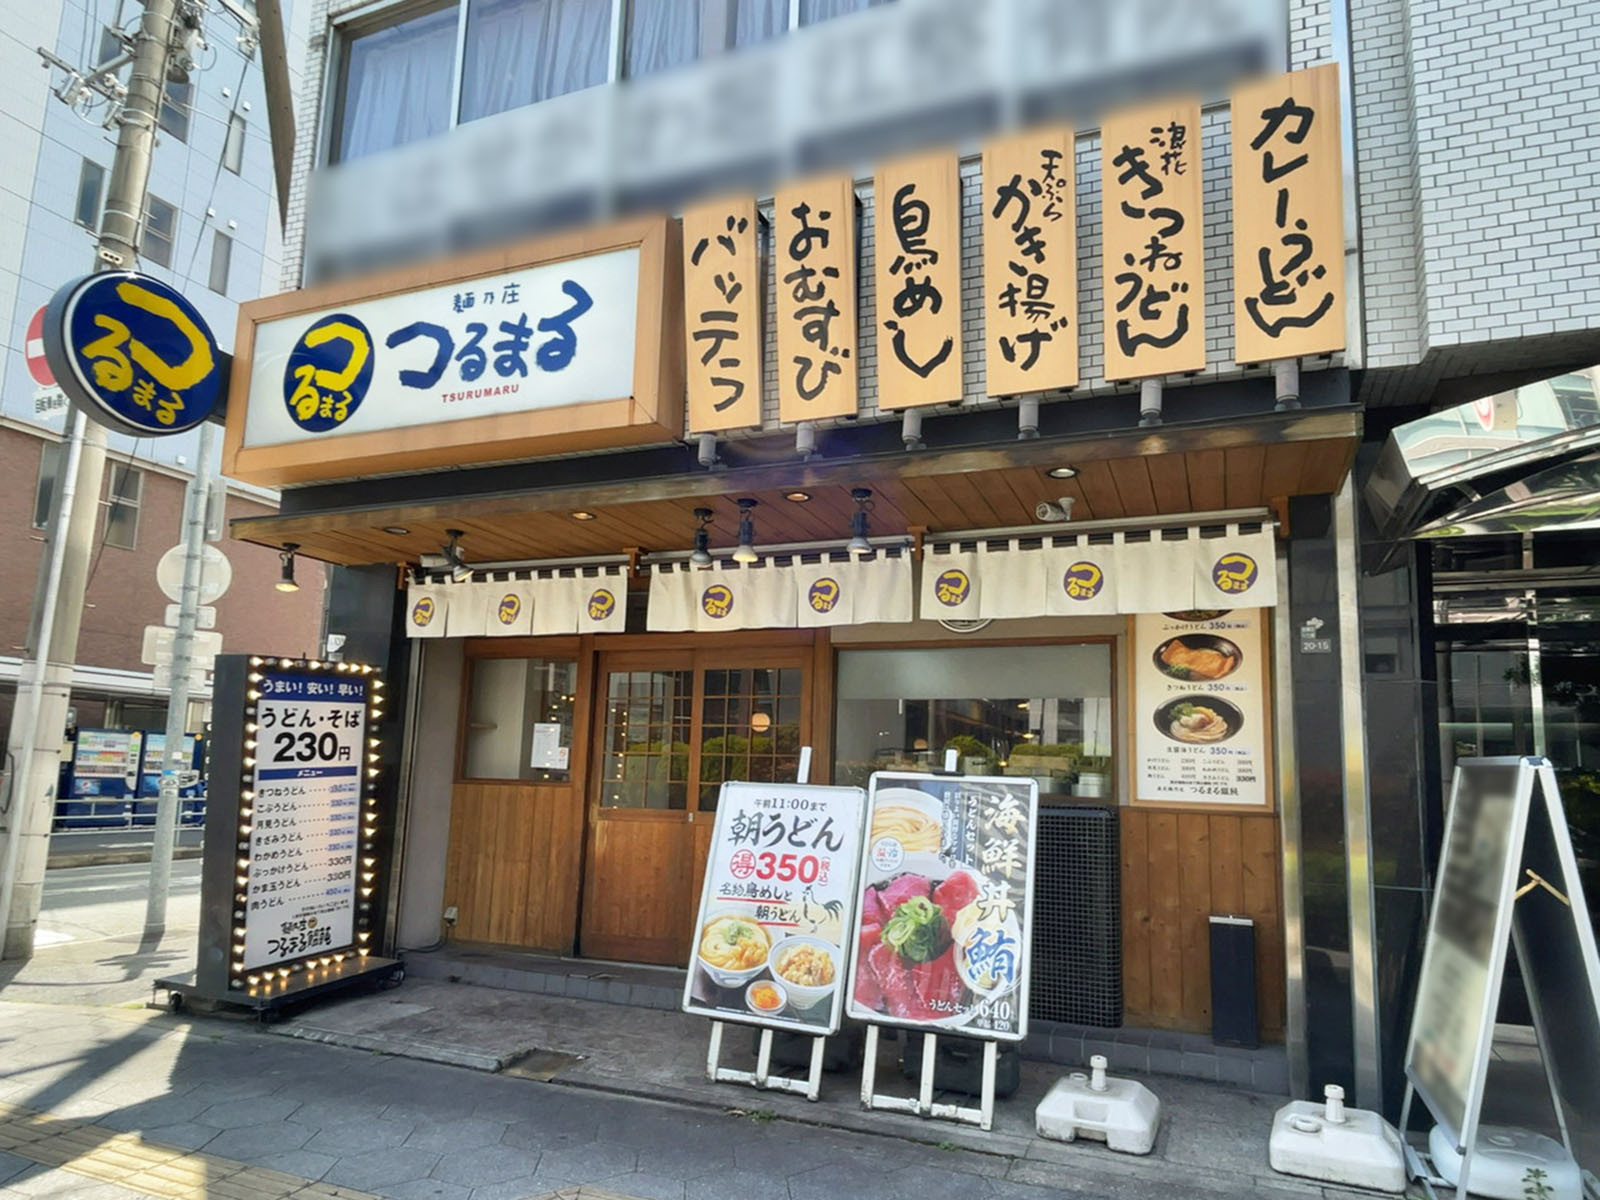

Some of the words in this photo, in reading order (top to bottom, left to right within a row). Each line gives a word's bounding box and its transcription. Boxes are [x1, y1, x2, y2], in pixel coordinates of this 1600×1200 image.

[1149, 121, 1187, 176] 浪花
[1040, 149, 1067, 222] 天ぷら
[1243, 97, 1335, 338] カレーうどん
[783, 201, 851, 401] おむすび
[882, 183, 954, 379] 鳥めし
[992, 174, 1068, 372] かき揚げ
[385, 279, 594, 390] つるまる
[691, 214, 749, 413] バッテラ
[441, 383, 520, 404] TSURUMARU
[262, 680, 303, 694] うまい!
[261, 707, 362, 728] うどん・そば
[273, 731, 351, 763] 230円
[728, 808, 845, 852] 朝うどん
[756, 851, 819, 884] 350
[966, 926, 1017, 985] 鮪
